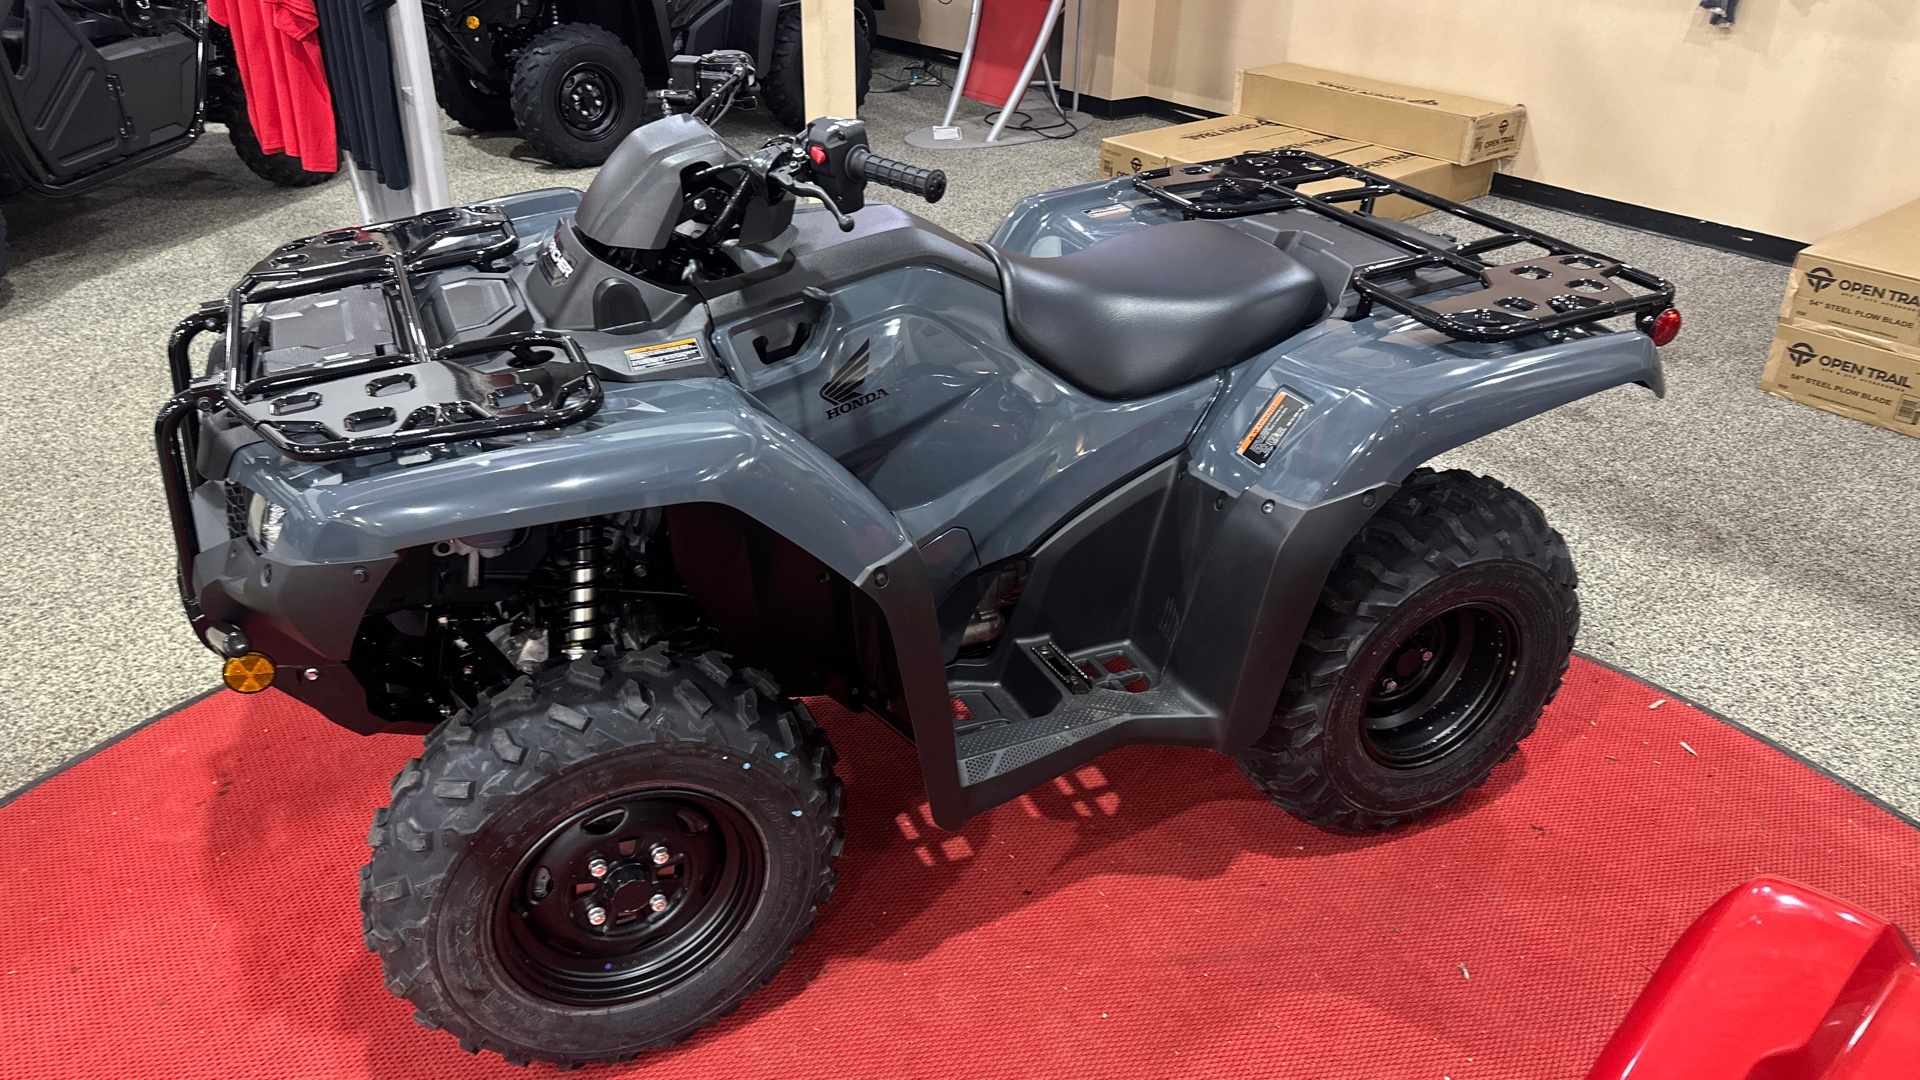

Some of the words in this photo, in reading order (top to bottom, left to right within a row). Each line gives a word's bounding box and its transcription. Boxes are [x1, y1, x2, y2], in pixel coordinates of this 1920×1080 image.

[1838, 279, 1887, 299] OPEN
[1824, 303, 1853, 315] STEEL
[1854, 310, 1881, 321] PLOW
[1882, 316, 1915, 329] BLADE
[1819, 355, 1866, 376] OPEN
[1867, 366, 1913, 389] TRAIL
[825, 388, 889, 420] HONDA
[1805, 378, 1833, 390] STEEL
[1834, 385, 1861, 397] PLOW
[1861, 392, 1893, 406] BLADE
